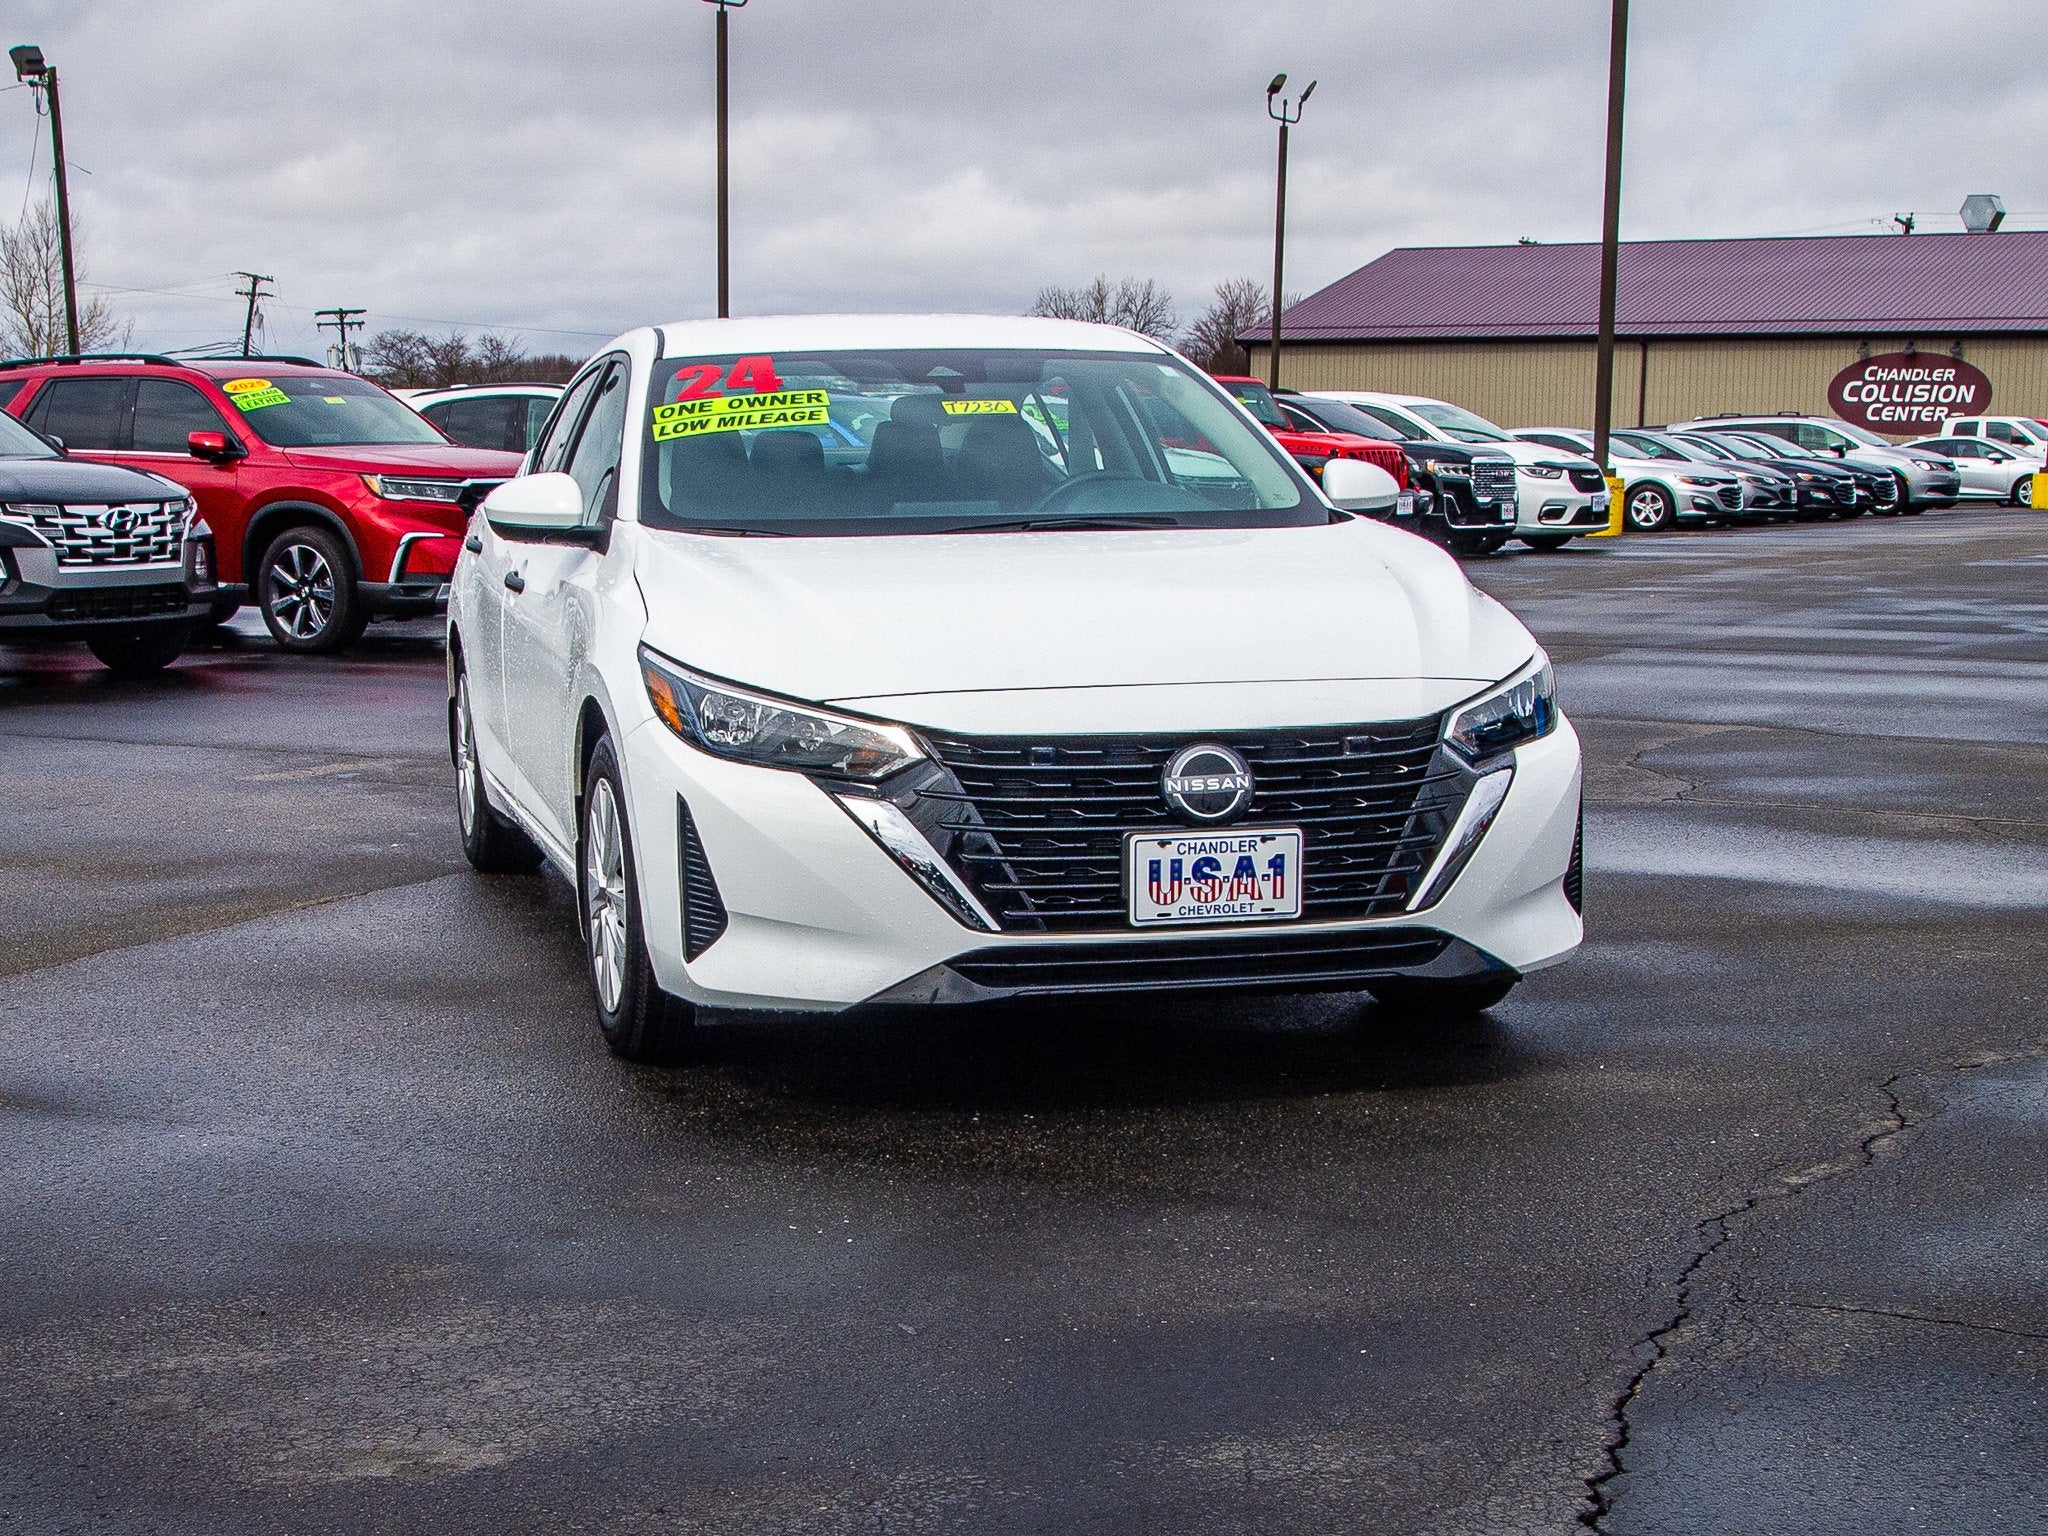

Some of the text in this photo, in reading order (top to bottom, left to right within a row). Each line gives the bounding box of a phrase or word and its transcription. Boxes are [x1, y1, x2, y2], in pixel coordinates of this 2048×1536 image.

[675, 355, 784, 401] 24
[1864, 366, 1956, 382] CHANDLER
[231, 381, 266, 391] 2025
[1842, 380, 1976, 403] COLLISION
[659, 392, 823, 419] ONE OWNER
[1866, 403, 1949, 422] CENTER
[658, 409, 822, 437] LOW MILEAGE
[1167, 775, 1249, 792] NISSAN
[1177, 840, 1258, 855] CHANDLER
[1178, 903, 1255, 916] CHEVROLET
